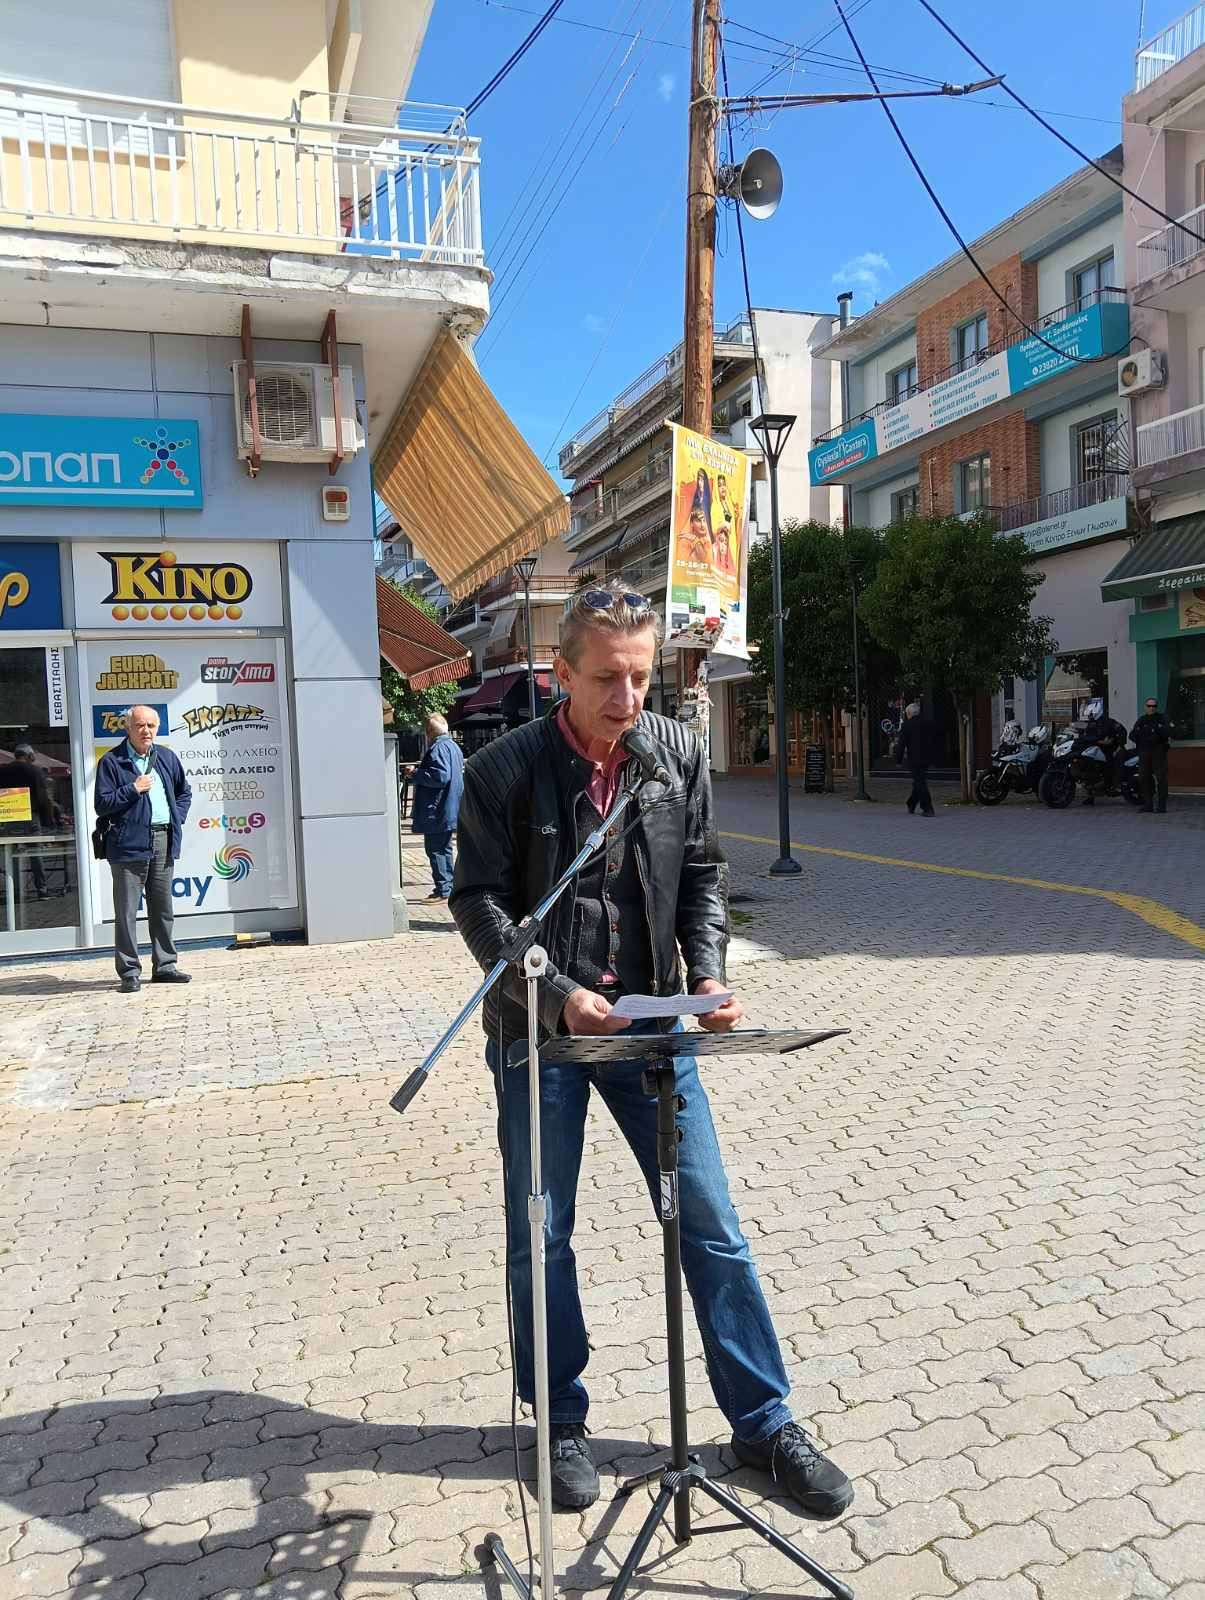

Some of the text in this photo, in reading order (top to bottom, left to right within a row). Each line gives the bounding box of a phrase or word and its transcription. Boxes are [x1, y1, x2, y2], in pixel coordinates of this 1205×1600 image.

[110, 655, 160, 672] EURO
[96, 671, 178, 690] JACKPOT
[229, 765, 276, 775] ΛΑΧΕΙΟ
